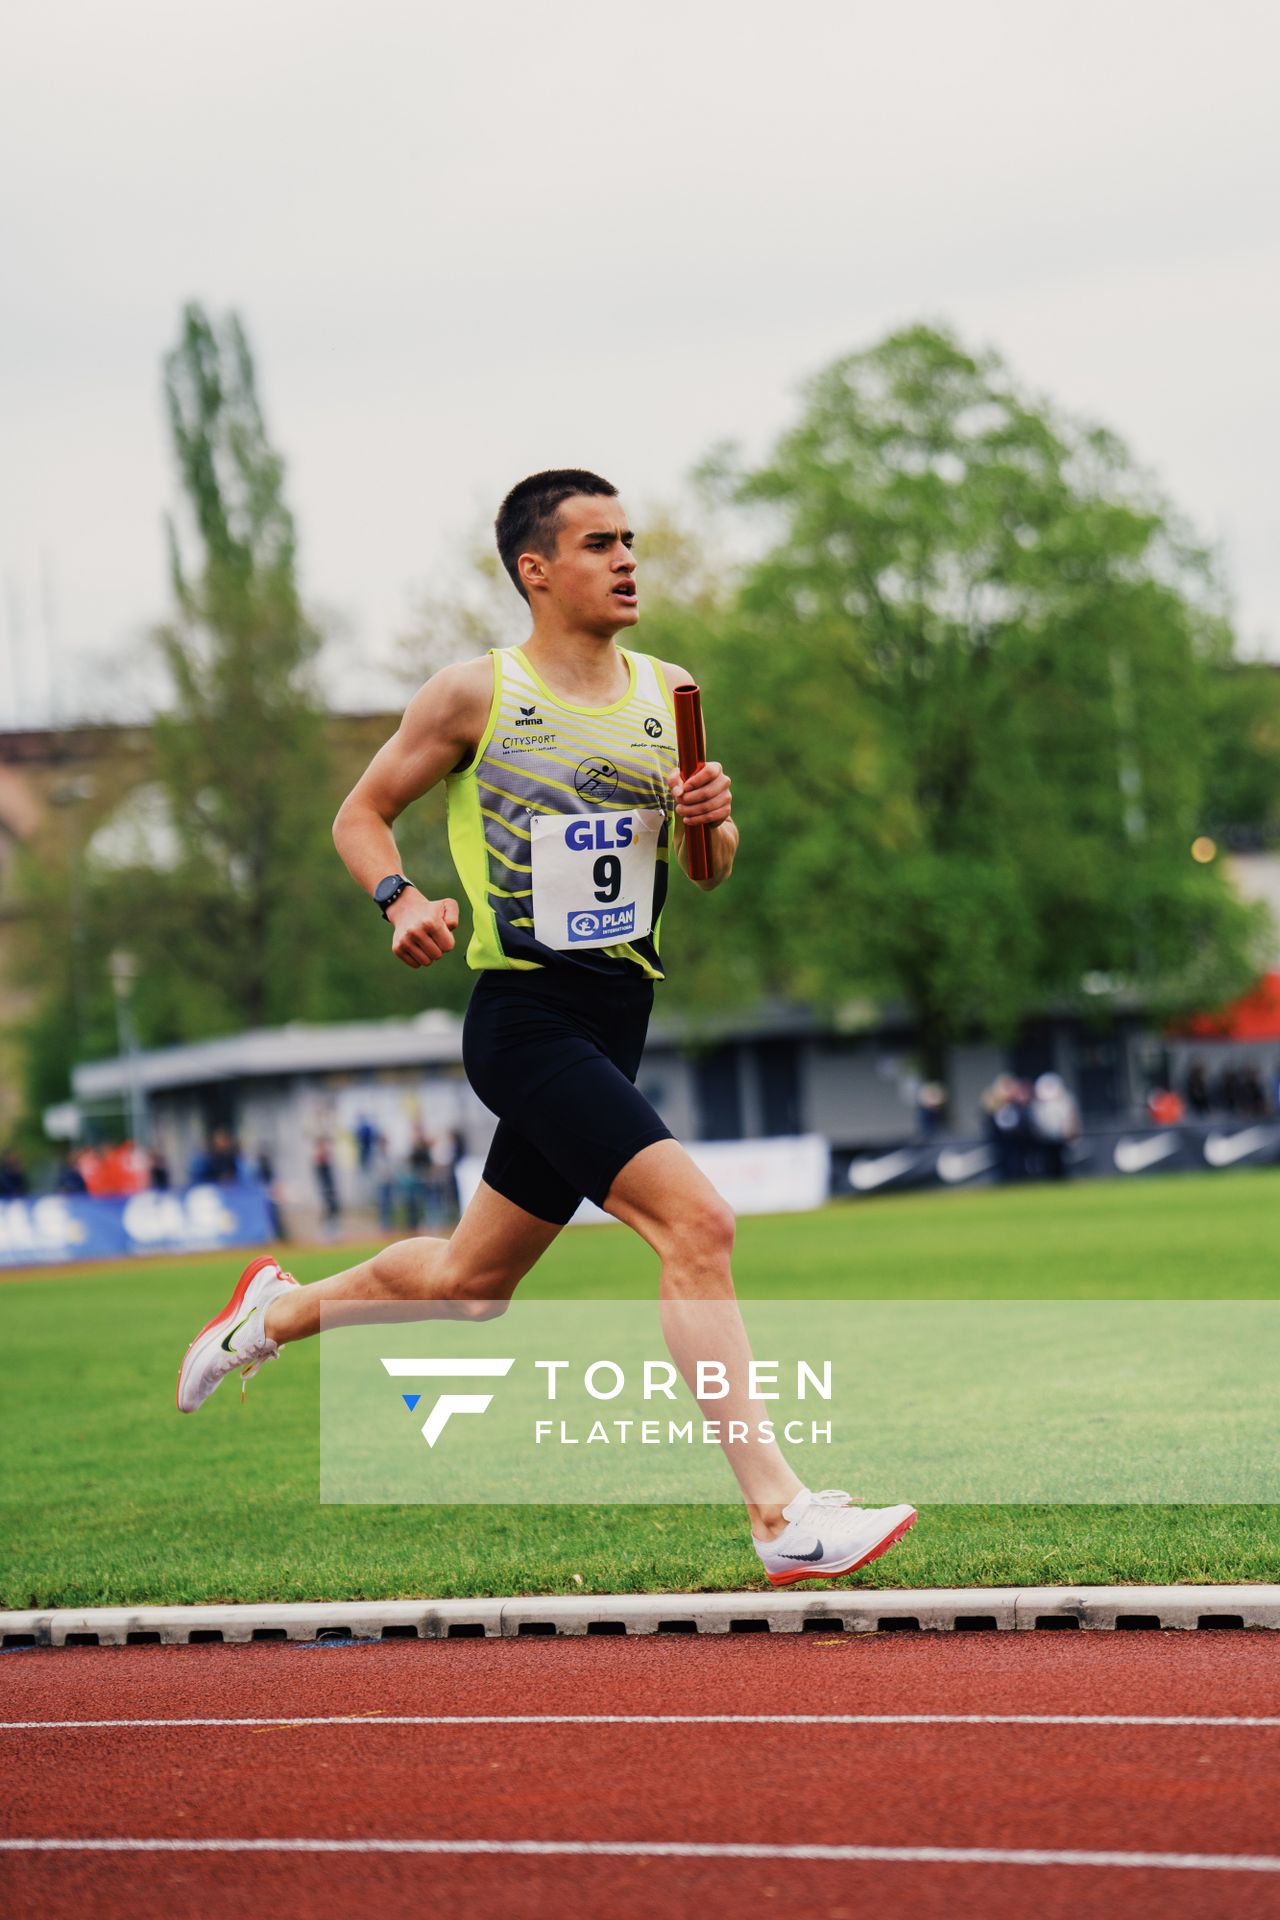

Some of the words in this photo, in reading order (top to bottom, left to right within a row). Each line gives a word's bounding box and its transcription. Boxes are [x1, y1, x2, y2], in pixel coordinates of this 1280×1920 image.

[515, 718, 543, 726] erima
[502, 735, 556, 749] CITYSPORT
[565, 817, 633, 851] GLS
[593, 855, 621, 903] 9
[602, 909, 633, 928] PLAN
